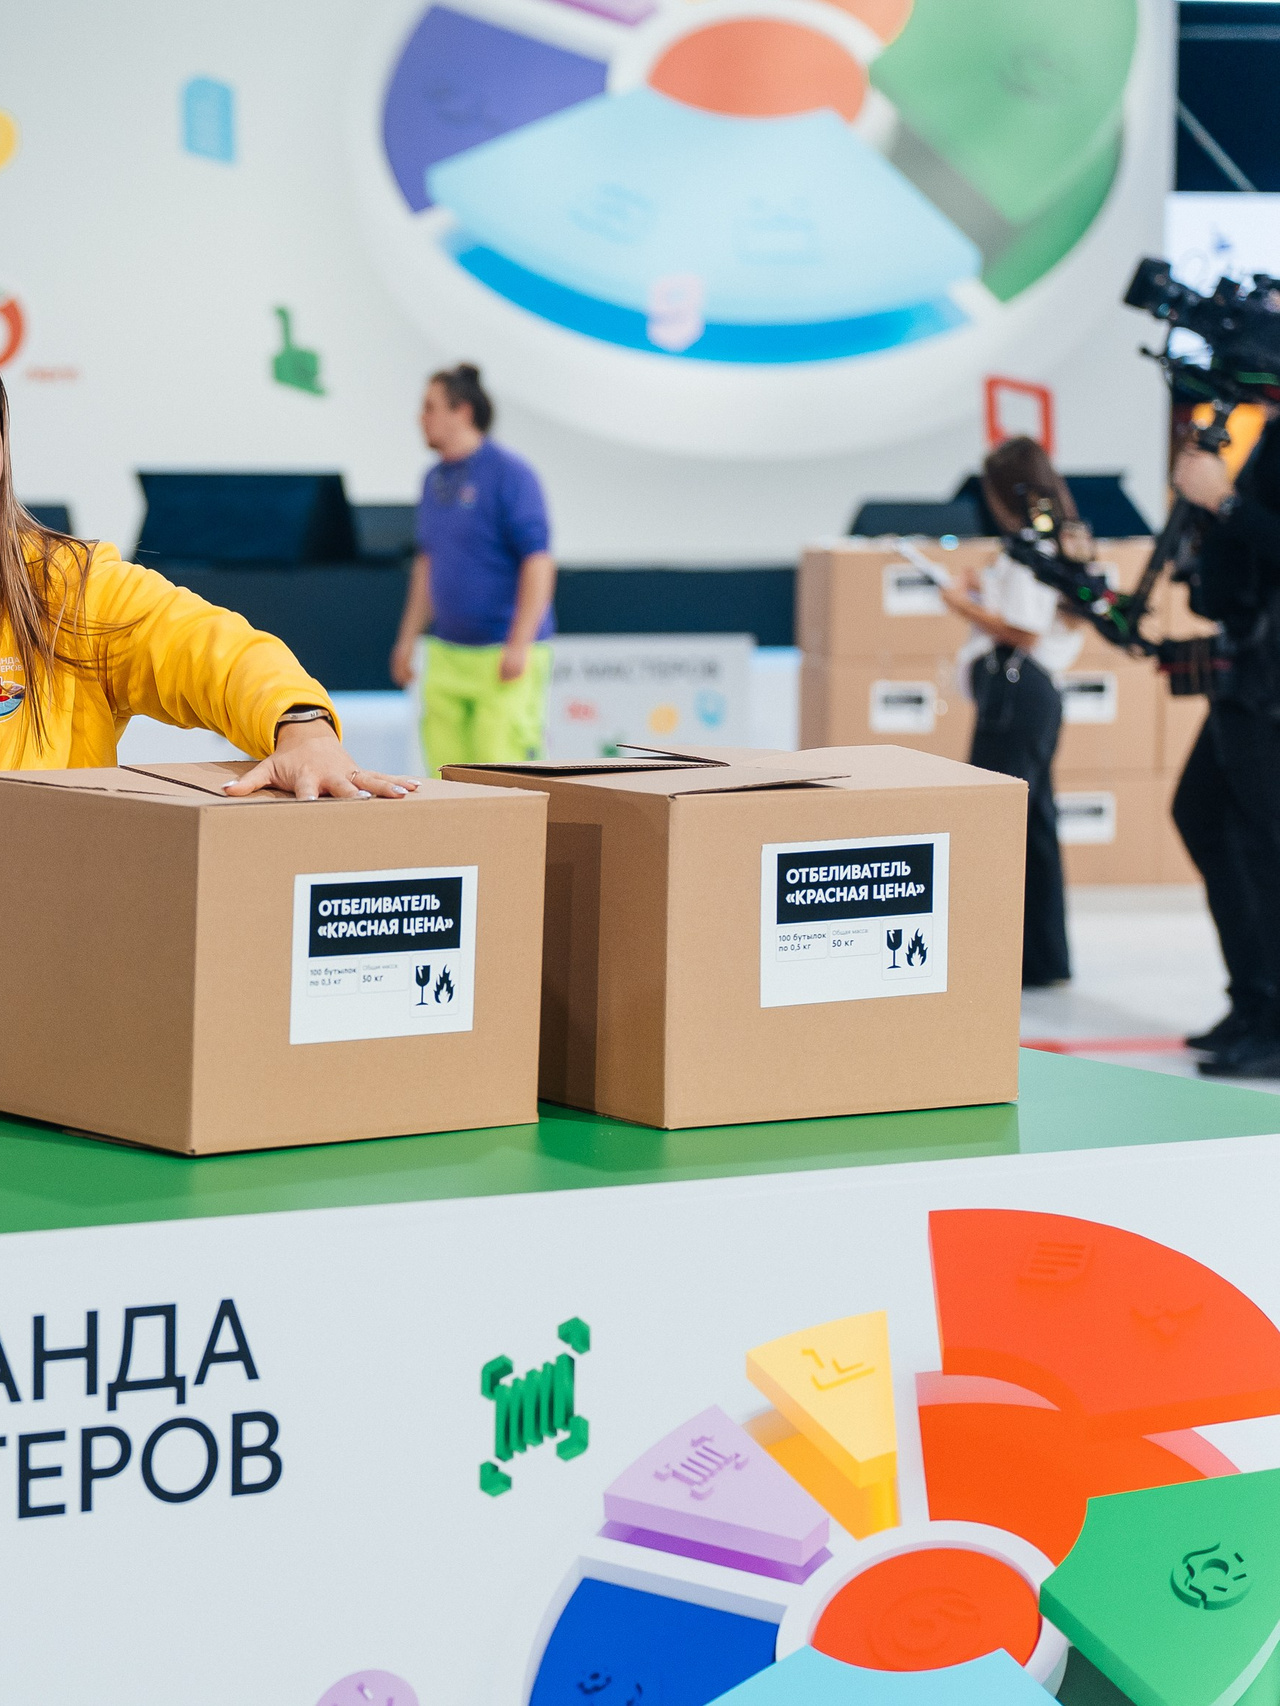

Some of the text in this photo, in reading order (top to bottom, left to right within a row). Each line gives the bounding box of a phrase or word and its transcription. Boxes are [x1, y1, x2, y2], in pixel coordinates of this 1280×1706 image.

[785, 861, 911, 884] ОТБЕЛИВАТЕЛЬ
[785, 881, 926, 905] «КРАСНАЯ ЦЕНА»
[318, 894, 441, 916] ОТБЕЛИВАТЕЛЬ
[317, 916, 454, 939] «КРАСНАЯ ЦЕНА»
[778, 932, 827, 943] 100 бутылок
[832, 939, 854, 948] 50 кг
